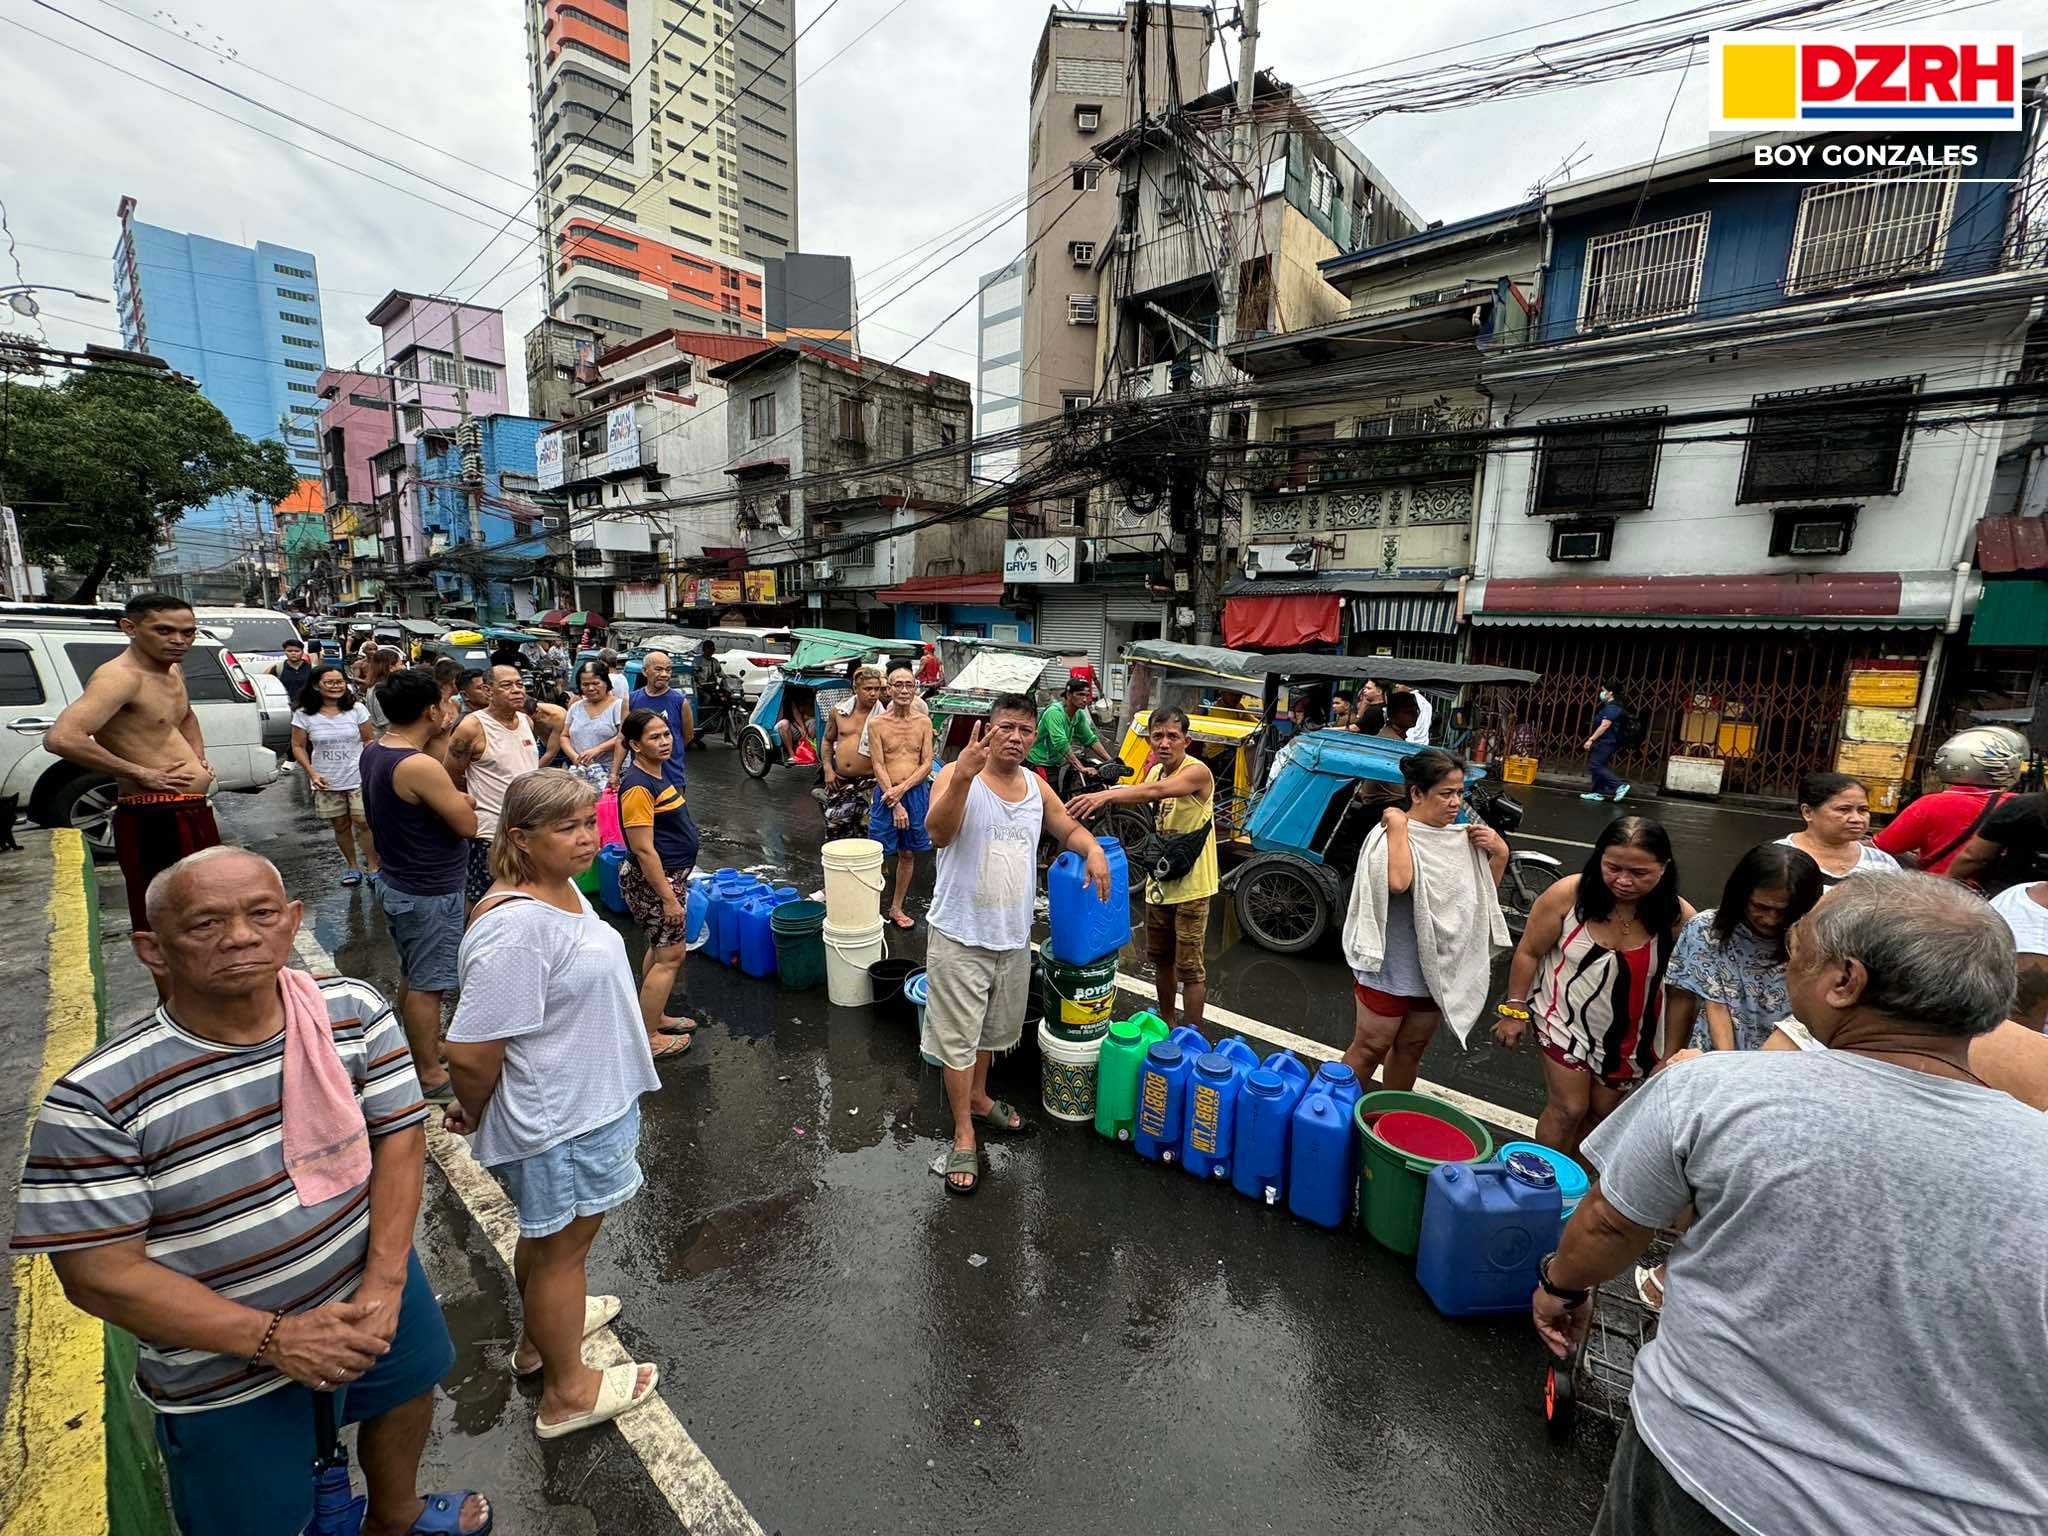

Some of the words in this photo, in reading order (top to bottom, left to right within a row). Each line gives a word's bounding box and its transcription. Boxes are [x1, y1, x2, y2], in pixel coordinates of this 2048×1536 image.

[1005, 561, 1038, 572] GAV'S
[322, 750, 351, 761] RISK
[1143, 1071, 1166, 1115] BOBBY
[1194, 1085, 1215, 1130] BOBBY
[1141, 1111, 1162, 1137] LIN
[1209, 1090, 1220, 1154] COUNCILOR
[1191, 1127, 1212, 1153] LIN
